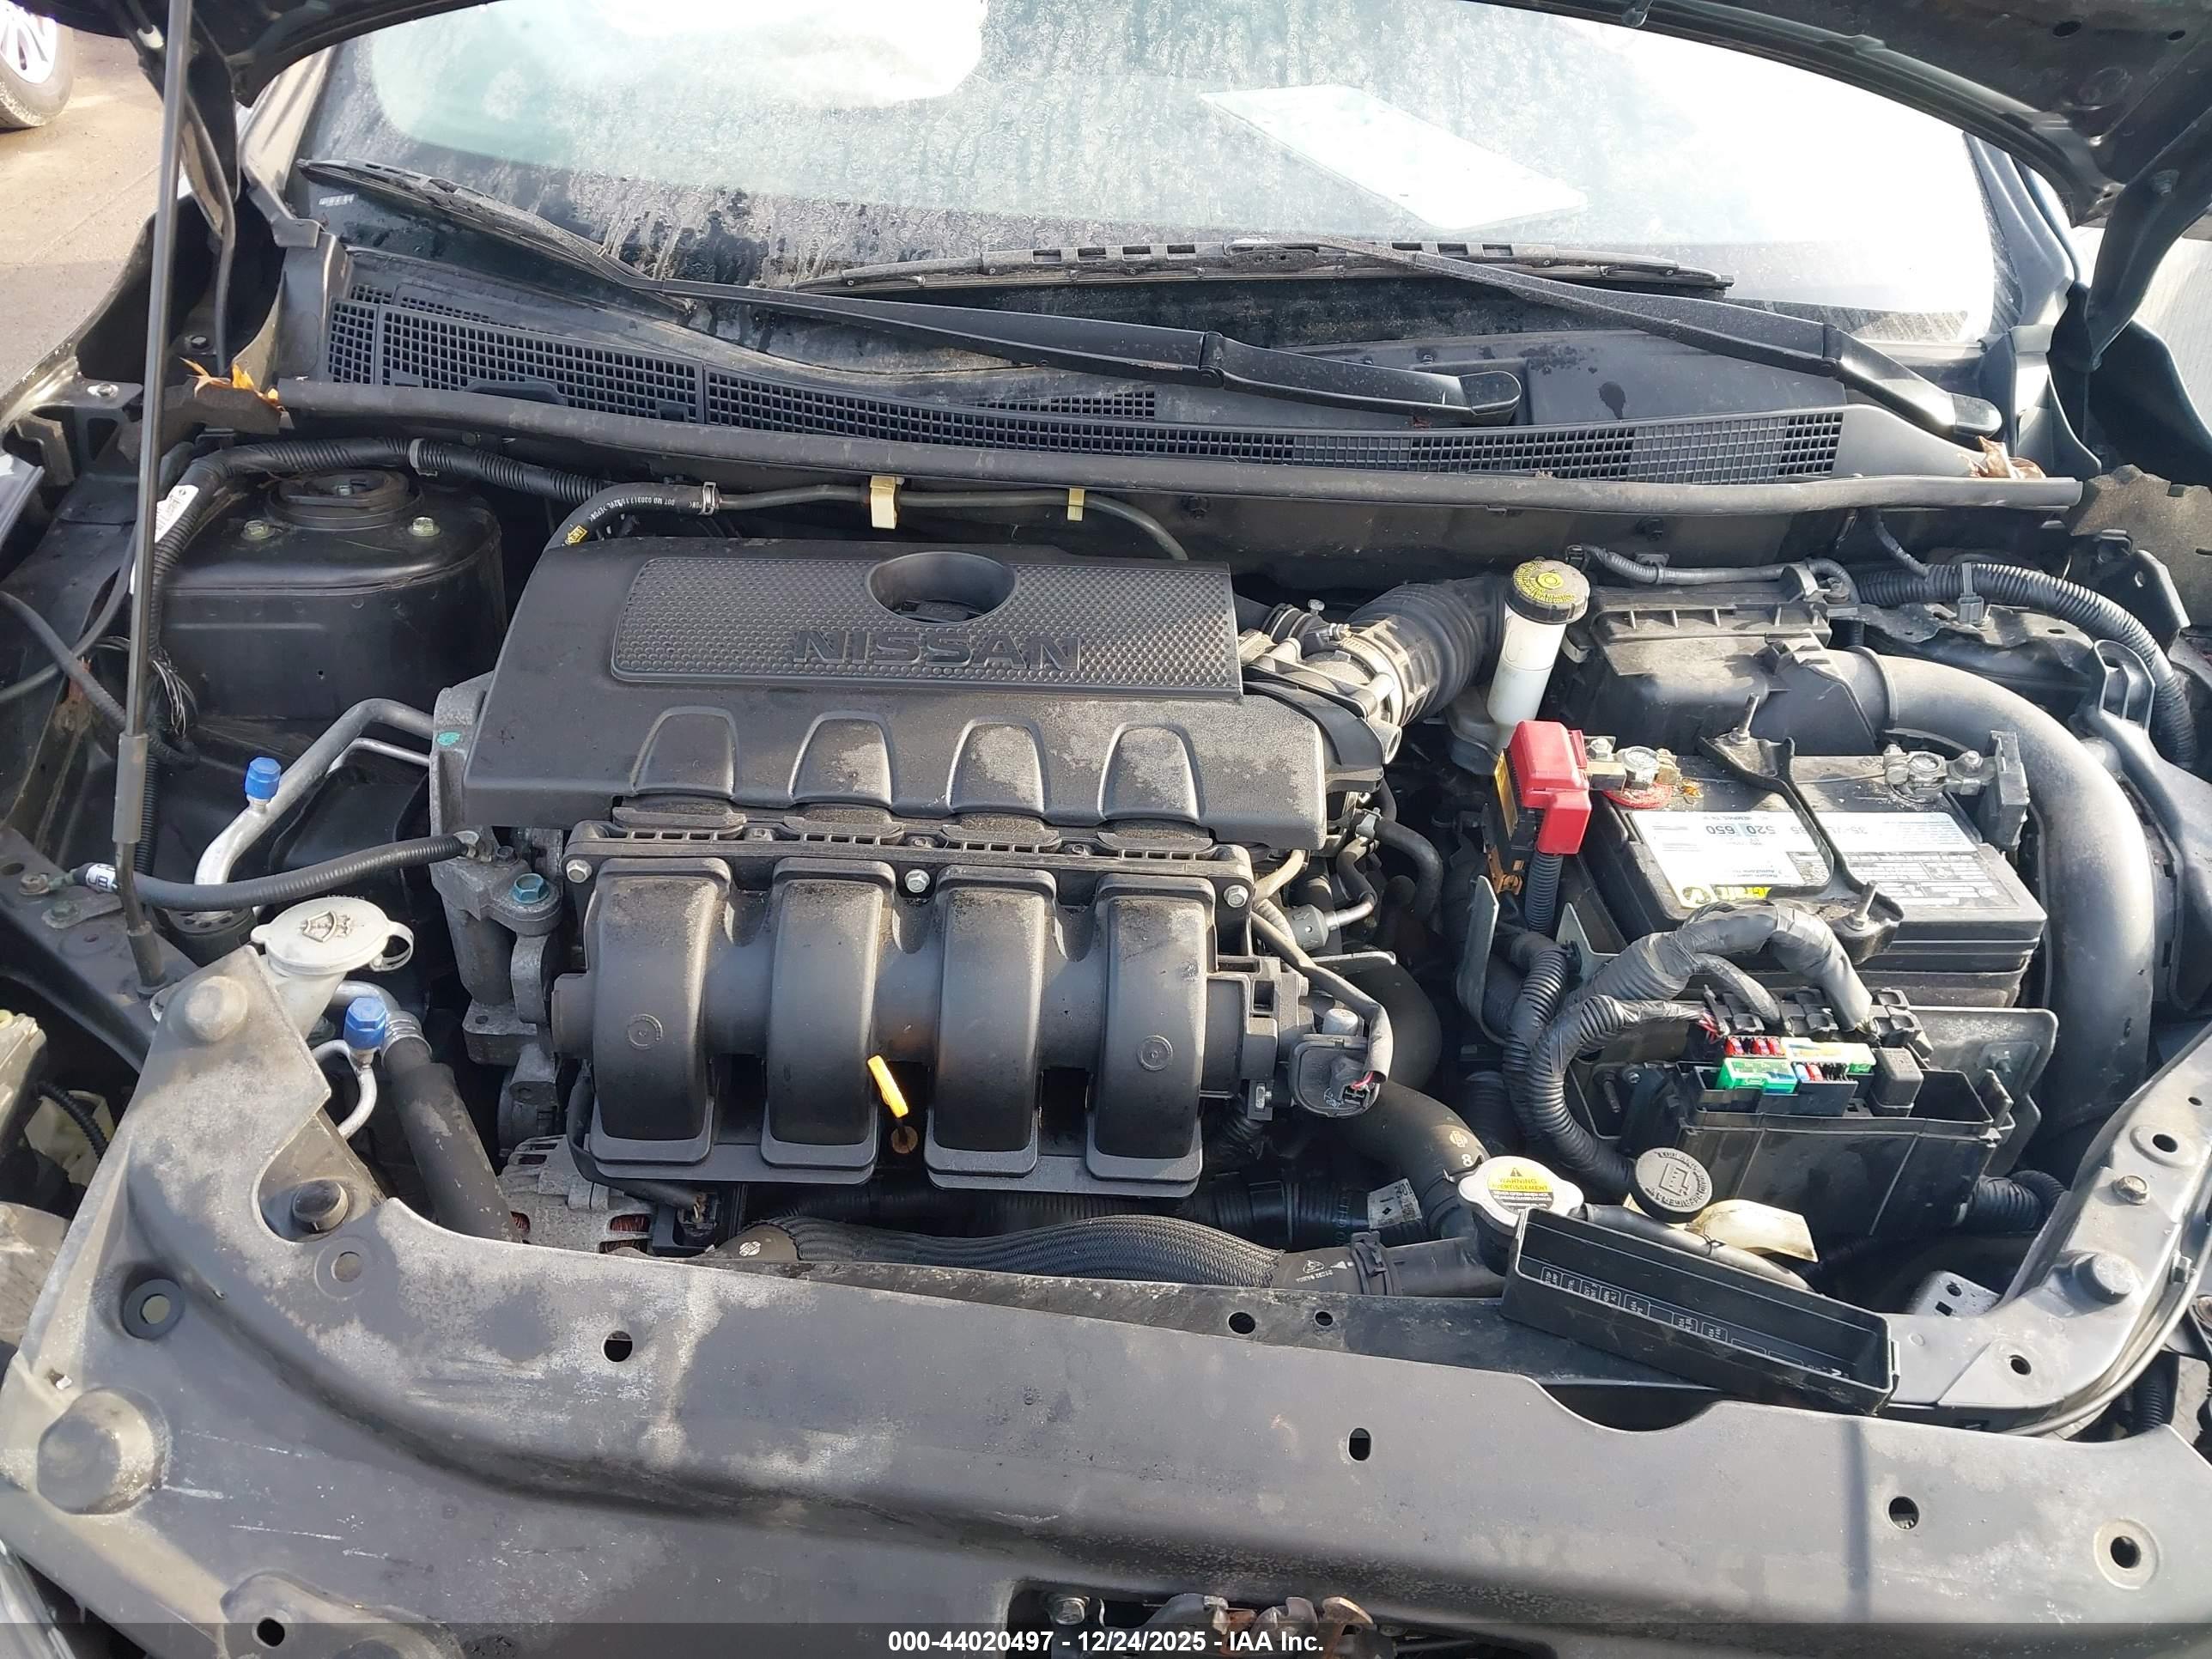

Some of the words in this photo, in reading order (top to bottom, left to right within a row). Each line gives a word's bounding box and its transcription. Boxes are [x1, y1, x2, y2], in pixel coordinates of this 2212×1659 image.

[792, 629, 1082, 672] NISSAN
[1705, 824, 1735, 835] 650
[1745, 824, 1776, 835] 520
